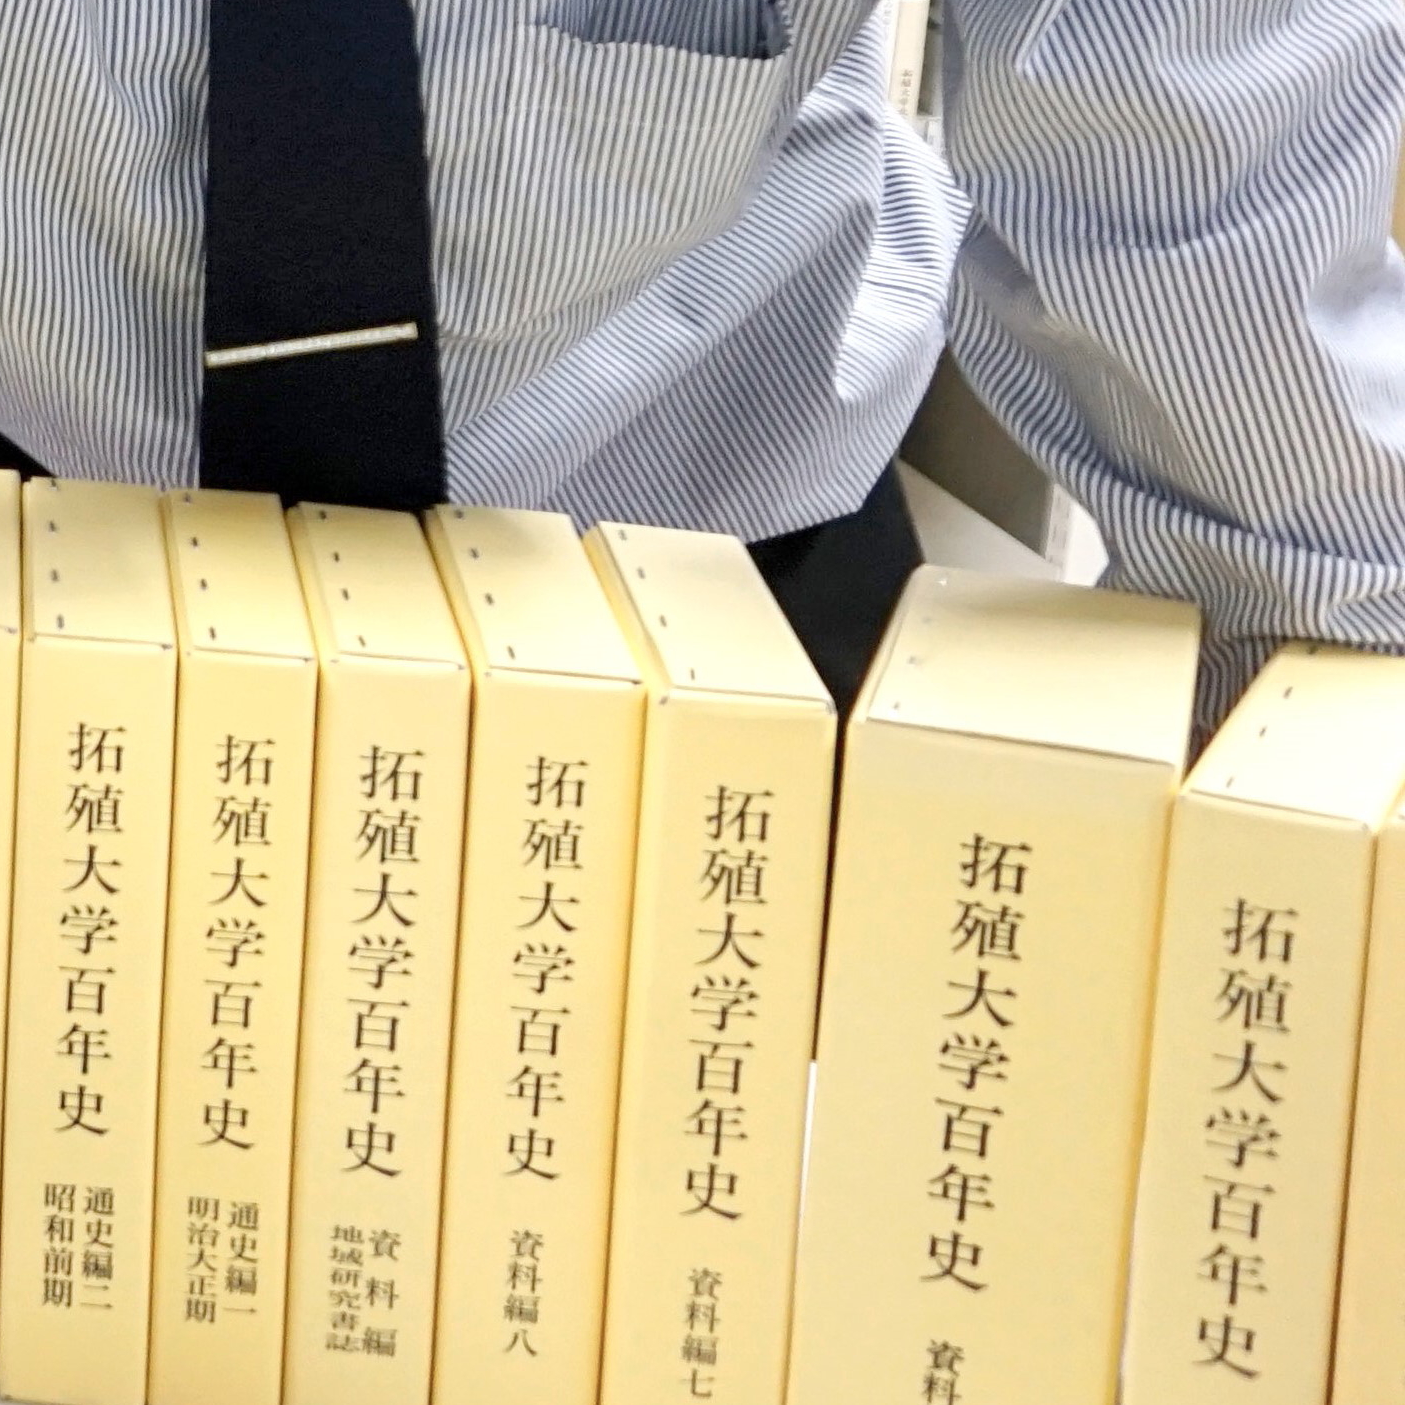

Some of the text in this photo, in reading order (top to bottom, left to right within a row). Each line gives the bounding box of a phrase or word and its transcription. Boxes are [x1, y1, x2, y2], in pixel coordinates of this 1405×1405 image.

[56, 721, 129, 1136] 拓殖大学百年史
[197, 733, 275, 1151] 拓殖大学百年史
[341, 744, 426, 1180] 拓殖大学百年史
[503, 754, 591, 1182] 拓殖大学百年史
[678, 785, 777, 1223] 拓殖大学百年史
[918, 831, 1034, 1295] 拓殖大学百年史
[1194, 896, 1301, 1381] 拓殖大学百年史
[41, 1181, 76, 1310] 昭和前期
[80, 1184, 115, 1311] 通史編二
[183, 1195, 222, 1326] 明治大正期
[224, 1199, 260, 1318] 通史編一
[323, 1223, 365, 1356] 地域研究書誌
[360, 1227, 403, 1359] 資料編
[502, 1227, 545, 1358] 資料編八
[680, 1266, 723, 1400] 資料編七
